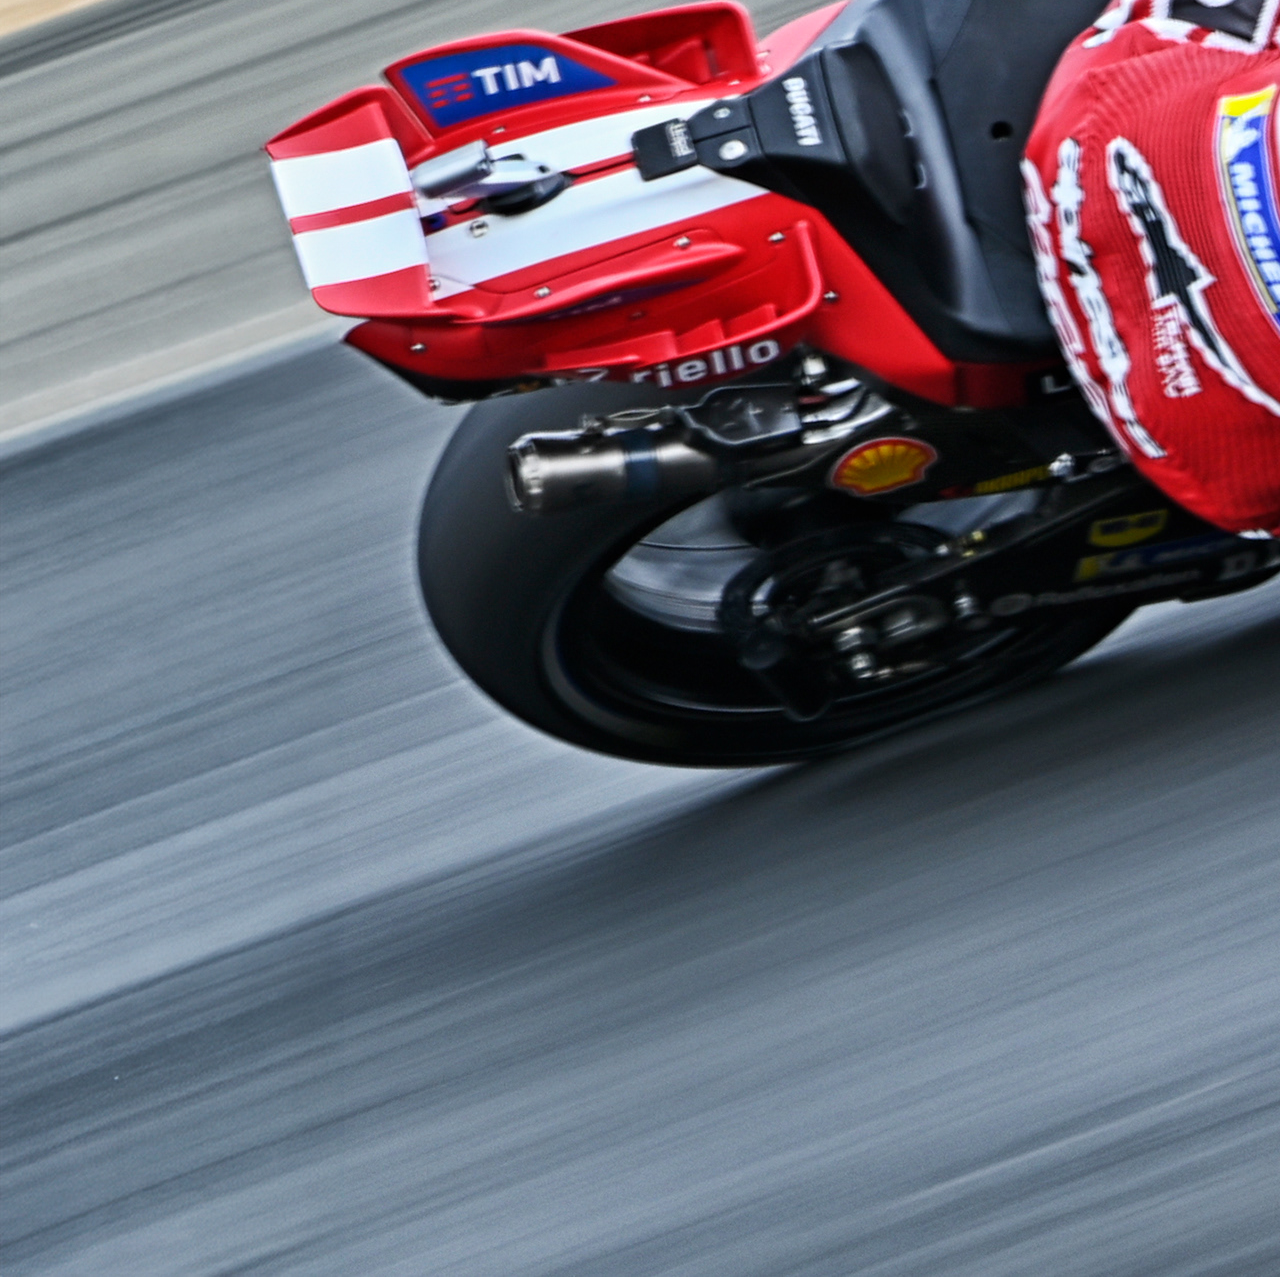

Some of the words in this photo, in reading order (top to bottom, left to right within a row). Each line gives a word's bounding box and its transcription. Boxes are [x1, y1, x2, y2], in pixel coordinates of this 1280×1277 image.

[470, 56, 562, 96] TIM
[781, 76, 823, 146] DUCATI
[631, 338, 780, 388] riello
